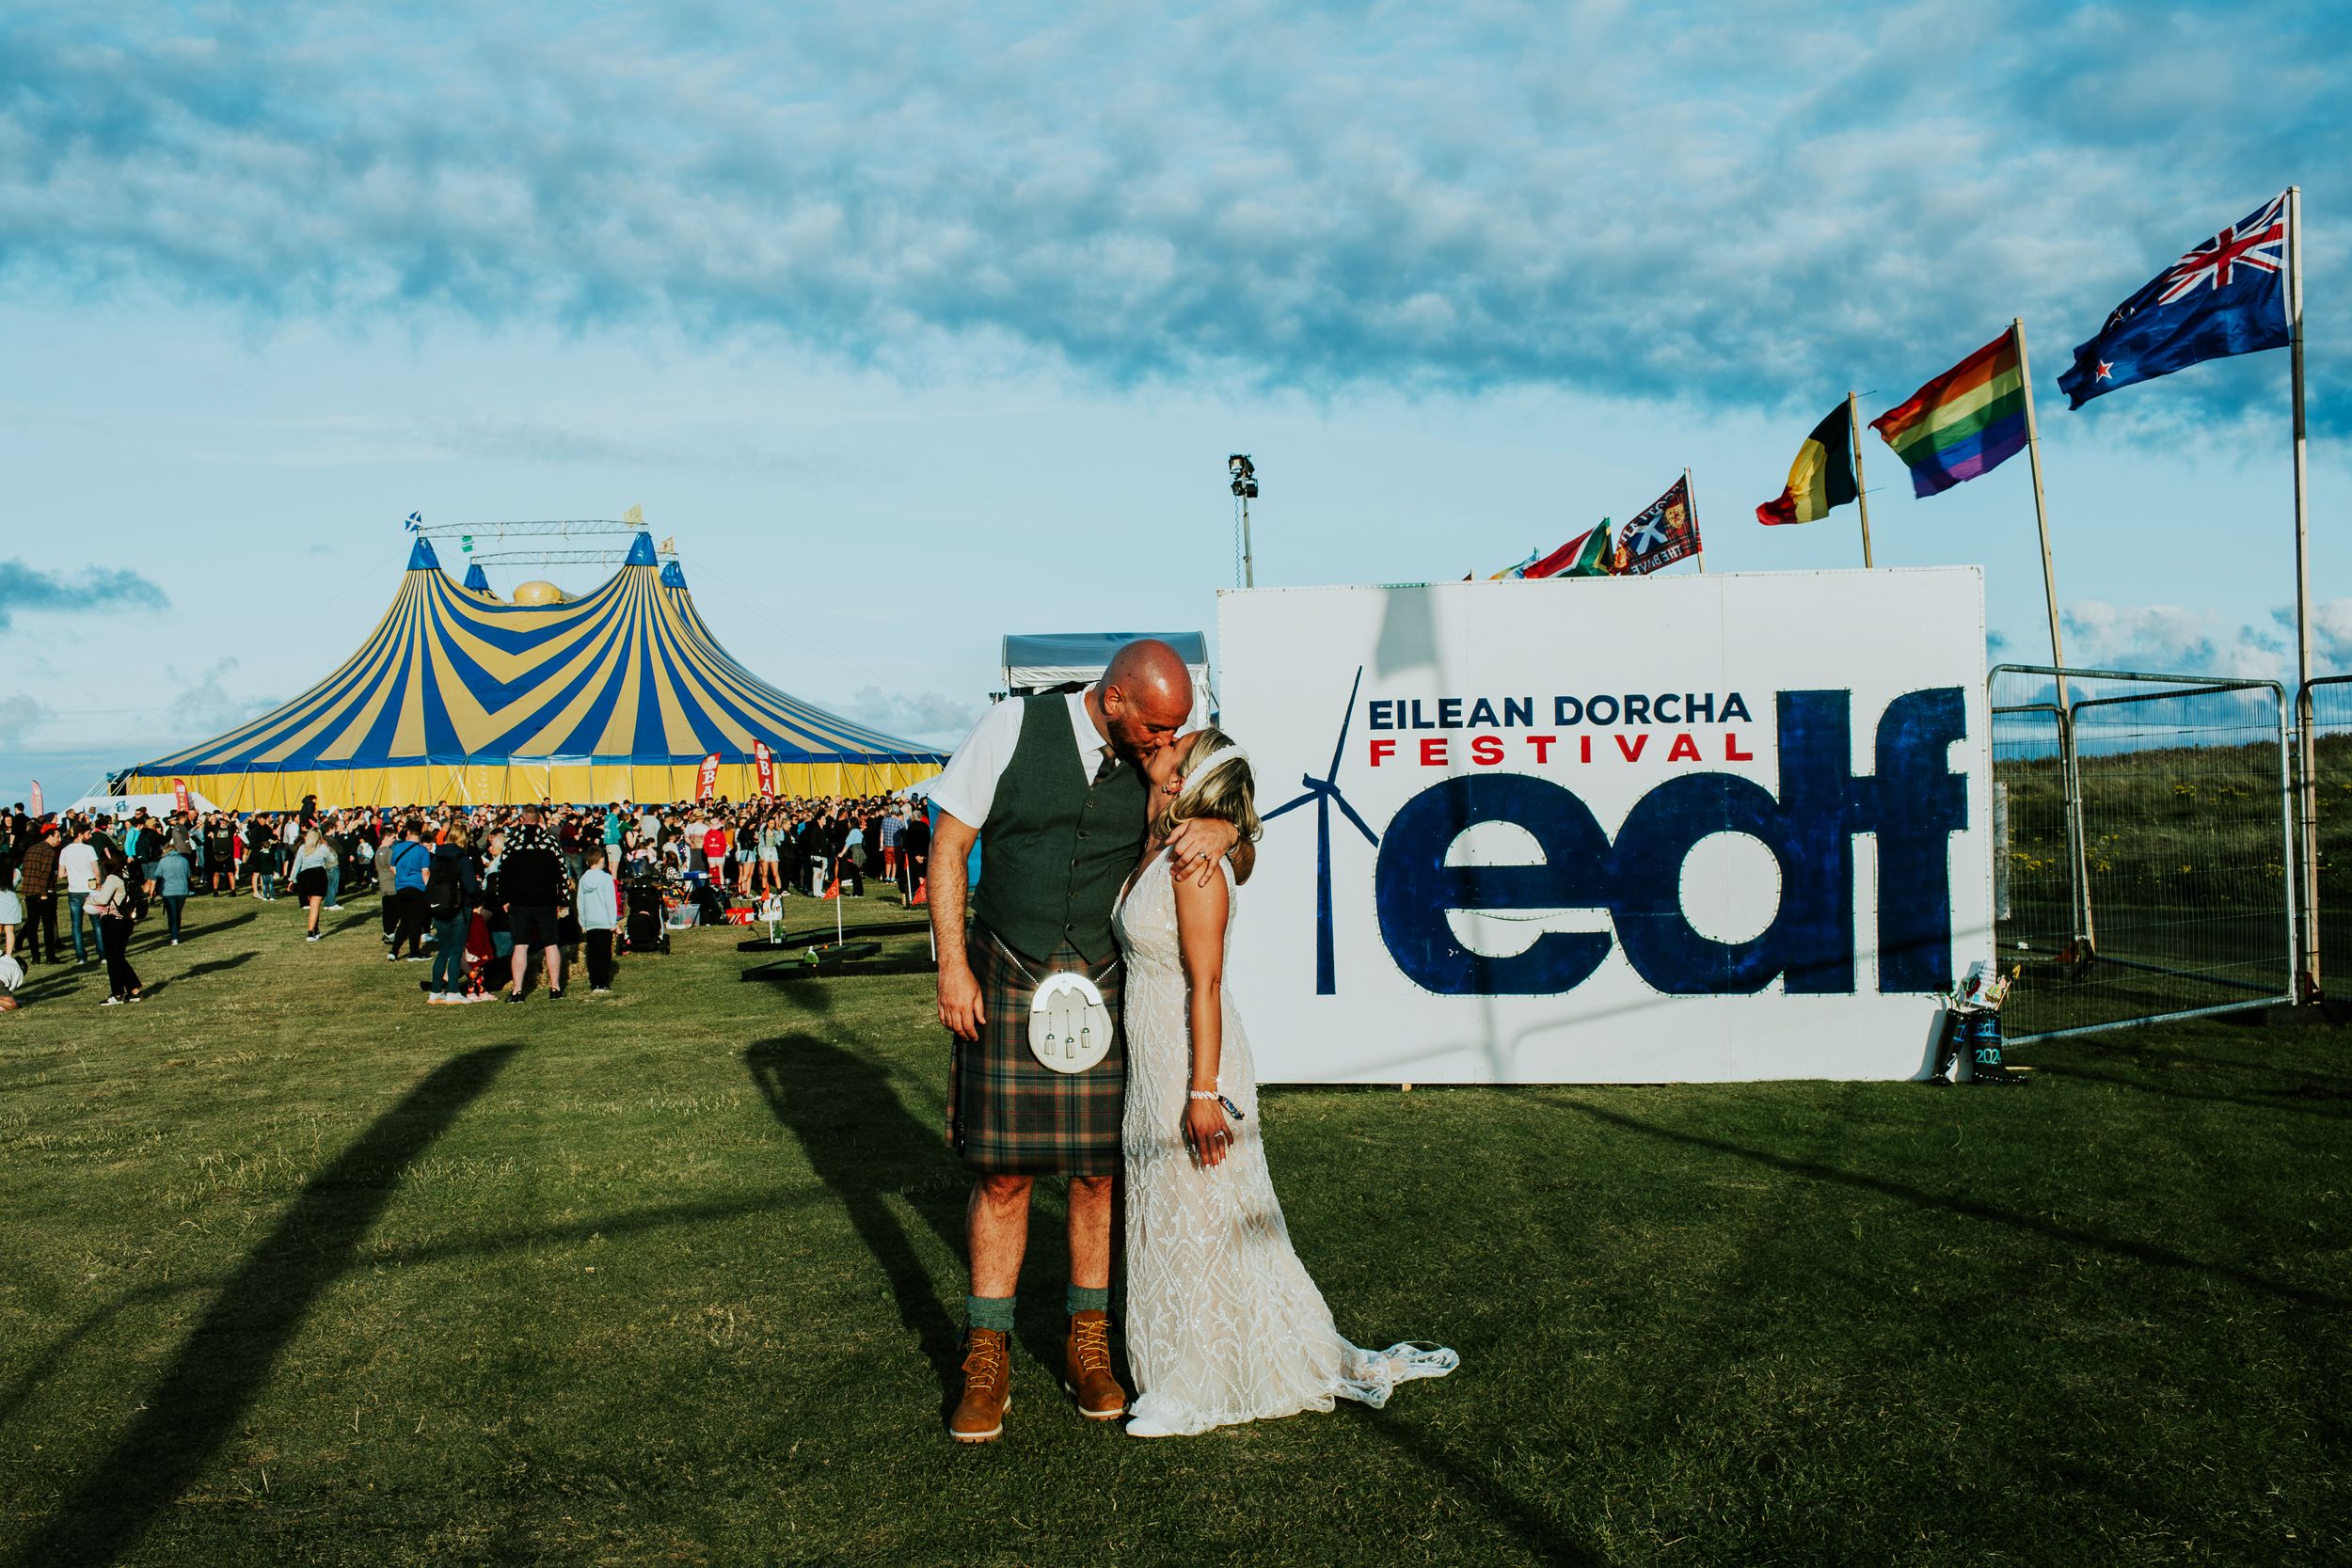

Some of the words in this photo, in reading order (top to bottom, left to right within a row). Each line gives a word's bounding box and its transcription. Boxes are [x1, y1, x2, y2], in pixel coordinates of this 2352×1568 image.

[1369, 696, 1534, 730] EILEAN
[1554, 691, 1753, 726] DORCHA
[1369, 734, 1754, 768] FESTIVAL
[1376, 687, 1968, 995] edf
[1977, 1019, 1995, 1035] edf
